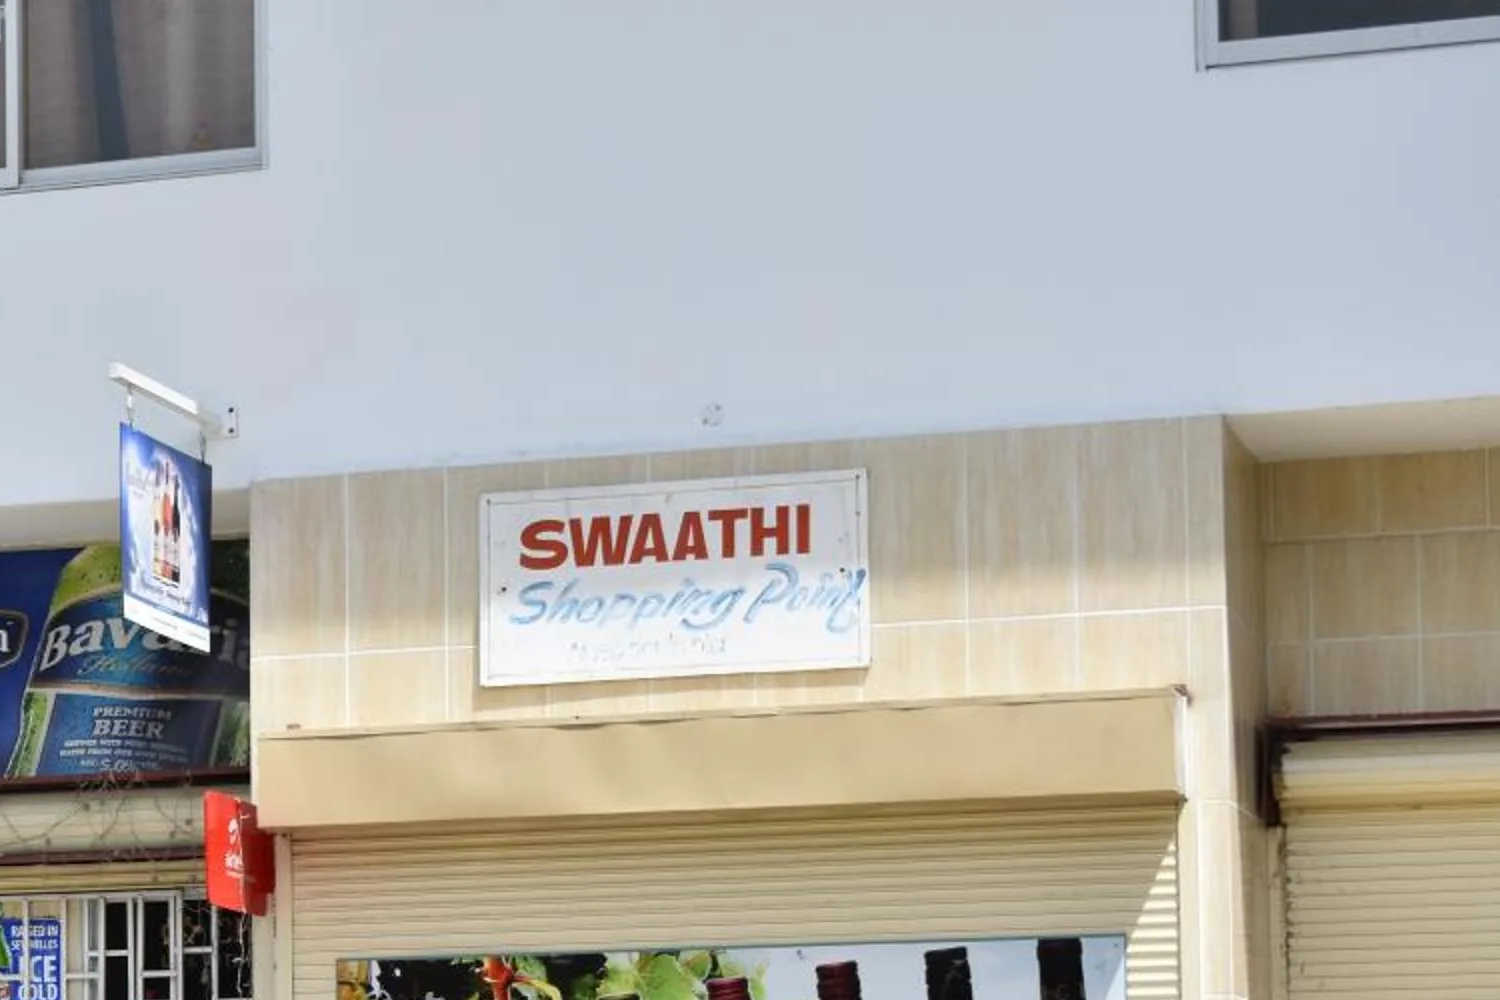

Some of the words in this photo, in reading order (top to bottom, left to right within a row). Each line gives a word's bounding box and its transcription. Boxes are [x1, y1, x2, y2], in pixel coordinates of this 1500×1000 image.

[518, 503, 811, 571] SWAATHI
[510, 576, 747, 631] Shopping
[40, 616, 250, 672] Bavi
[91, 718, 165, 739] BEER
[92, 705, 172, 721] PREMIUM
[19, 955, 58, 983] ICE
